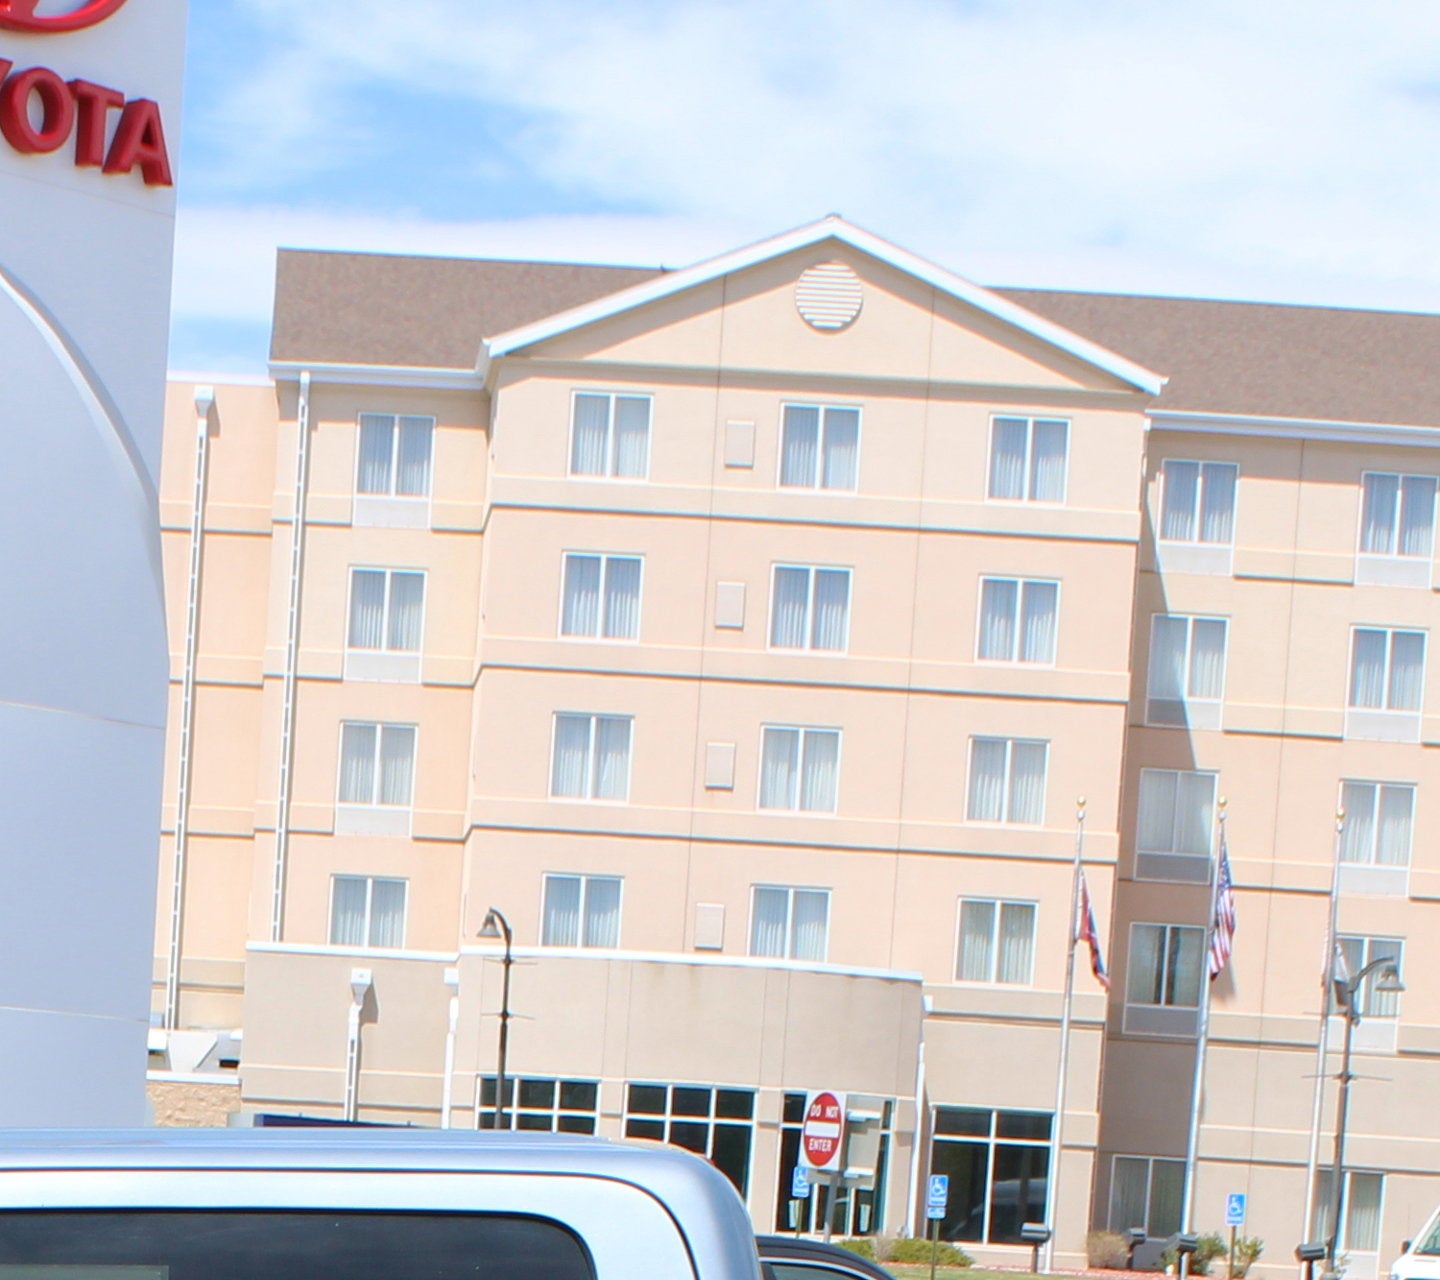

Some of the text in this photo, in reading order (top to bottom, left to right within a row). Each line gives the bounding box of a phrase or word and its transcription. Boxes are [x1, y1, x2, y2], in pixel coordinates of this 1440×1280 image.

[809, 1103, 840, 1119] DO NOT
[808, 1138, 833, 1152] ENTER
